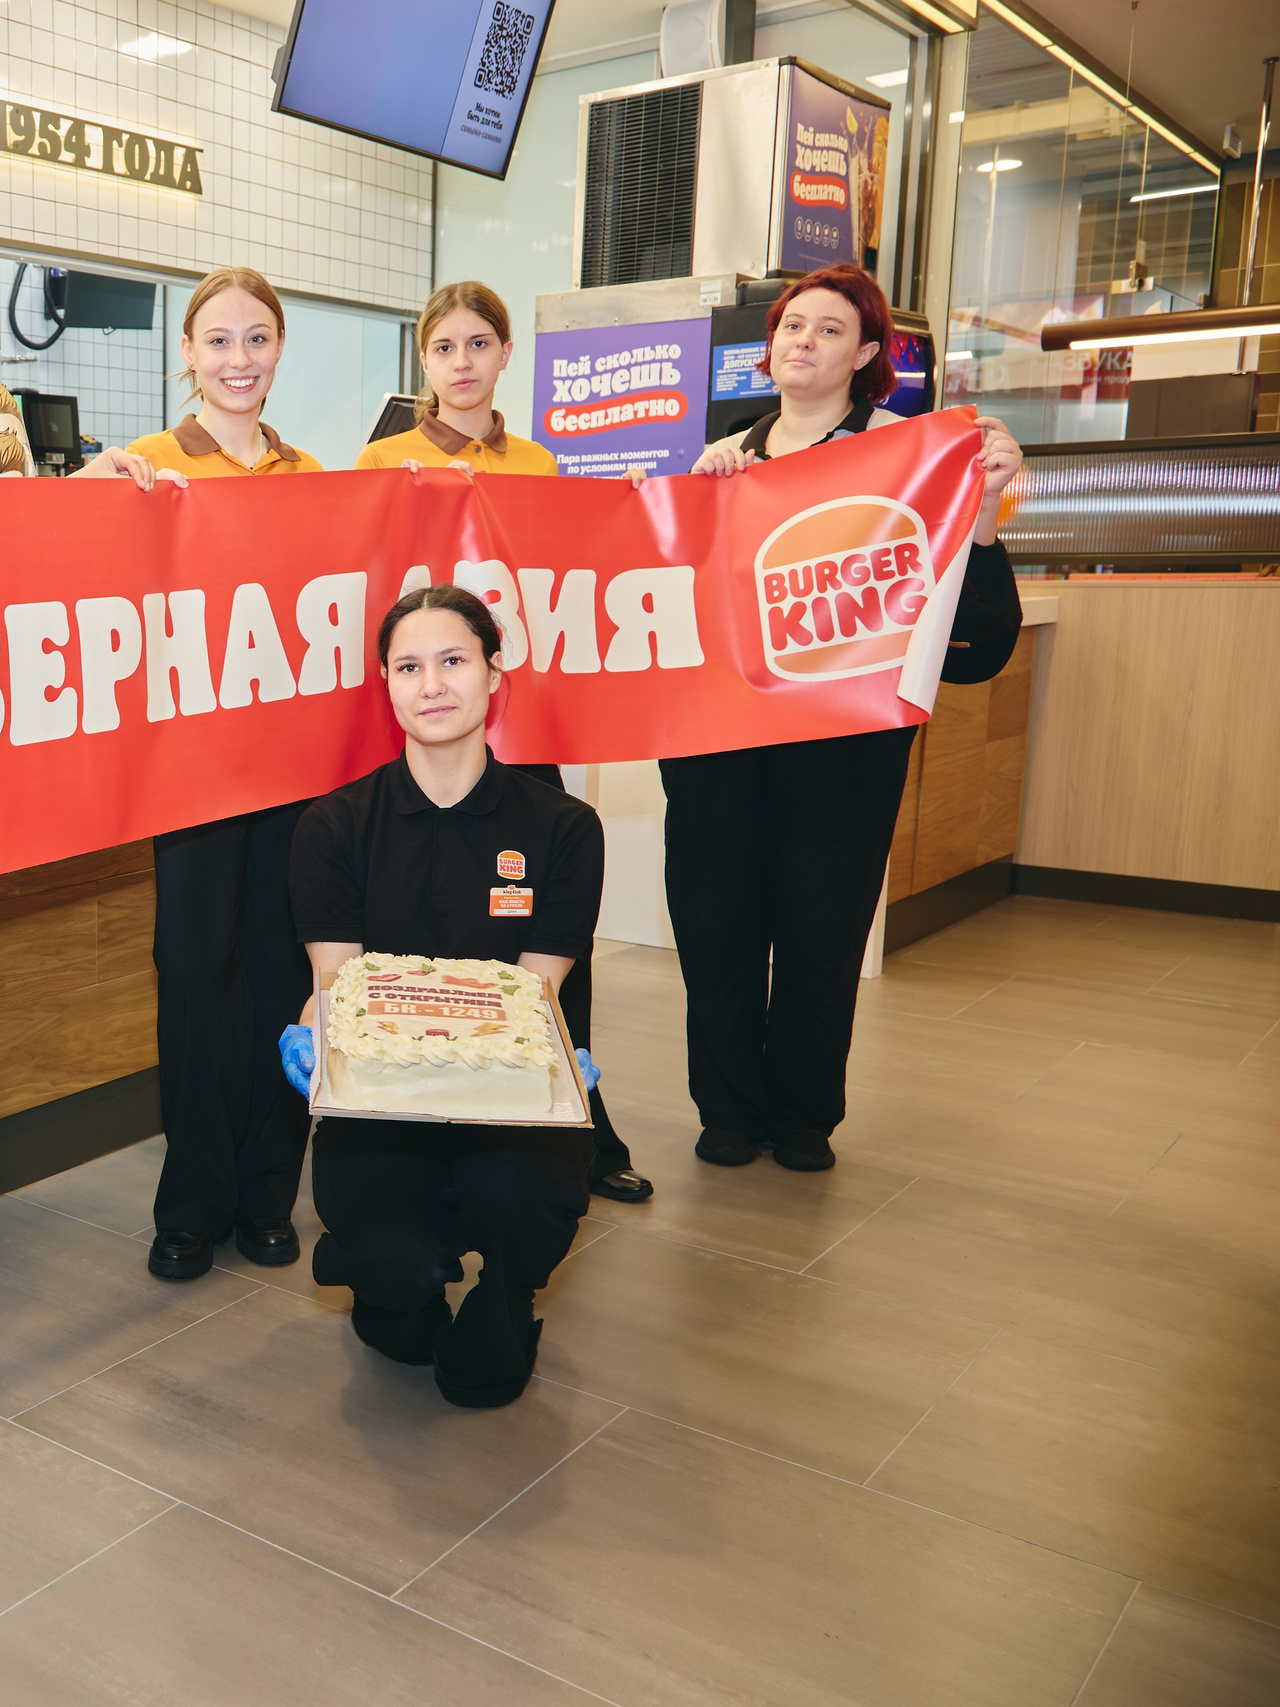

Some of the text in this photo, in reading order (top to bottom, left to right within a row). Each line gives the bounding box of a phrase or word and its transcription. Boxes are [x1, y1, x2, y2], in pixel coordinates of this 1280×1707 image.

[467, 110, 503, 130] быть для тебя
[475, 103, 501, 119] Мы хотим
[797, 124, 848, 153] Пей сколько
[101, 126, 204, 195] ГОДА
[795, 144, 847, 176] хочешь
[794, 175, 846, 205] бесплатно
[553, 344, 681, 377] Пей сколько
[552, 362, 681, 402] хочешь
[551, 399, 680, 432] бесплатно
[557, 449, 669, 464] Пара важных моментов
[568, 466, 579, 474] по
[581, 463, 625, 475] условиям
[763, 542, 924, 605] BURGER
[397, 559, 705, 674] ЗИЯ
[768, 577, 929, 652] KING
[499, 858, 524, 867] BURGER
[499, 865, 524, 874] KING
[367, 985, 503, 1000] ПОЗДРАВЛЯЕМ
[385, 993, 503, 1008] ОТКРЫТИЕМ
[384, 1003, 418, 1014] БК
[442, 1007, 499, 1020] 1249
